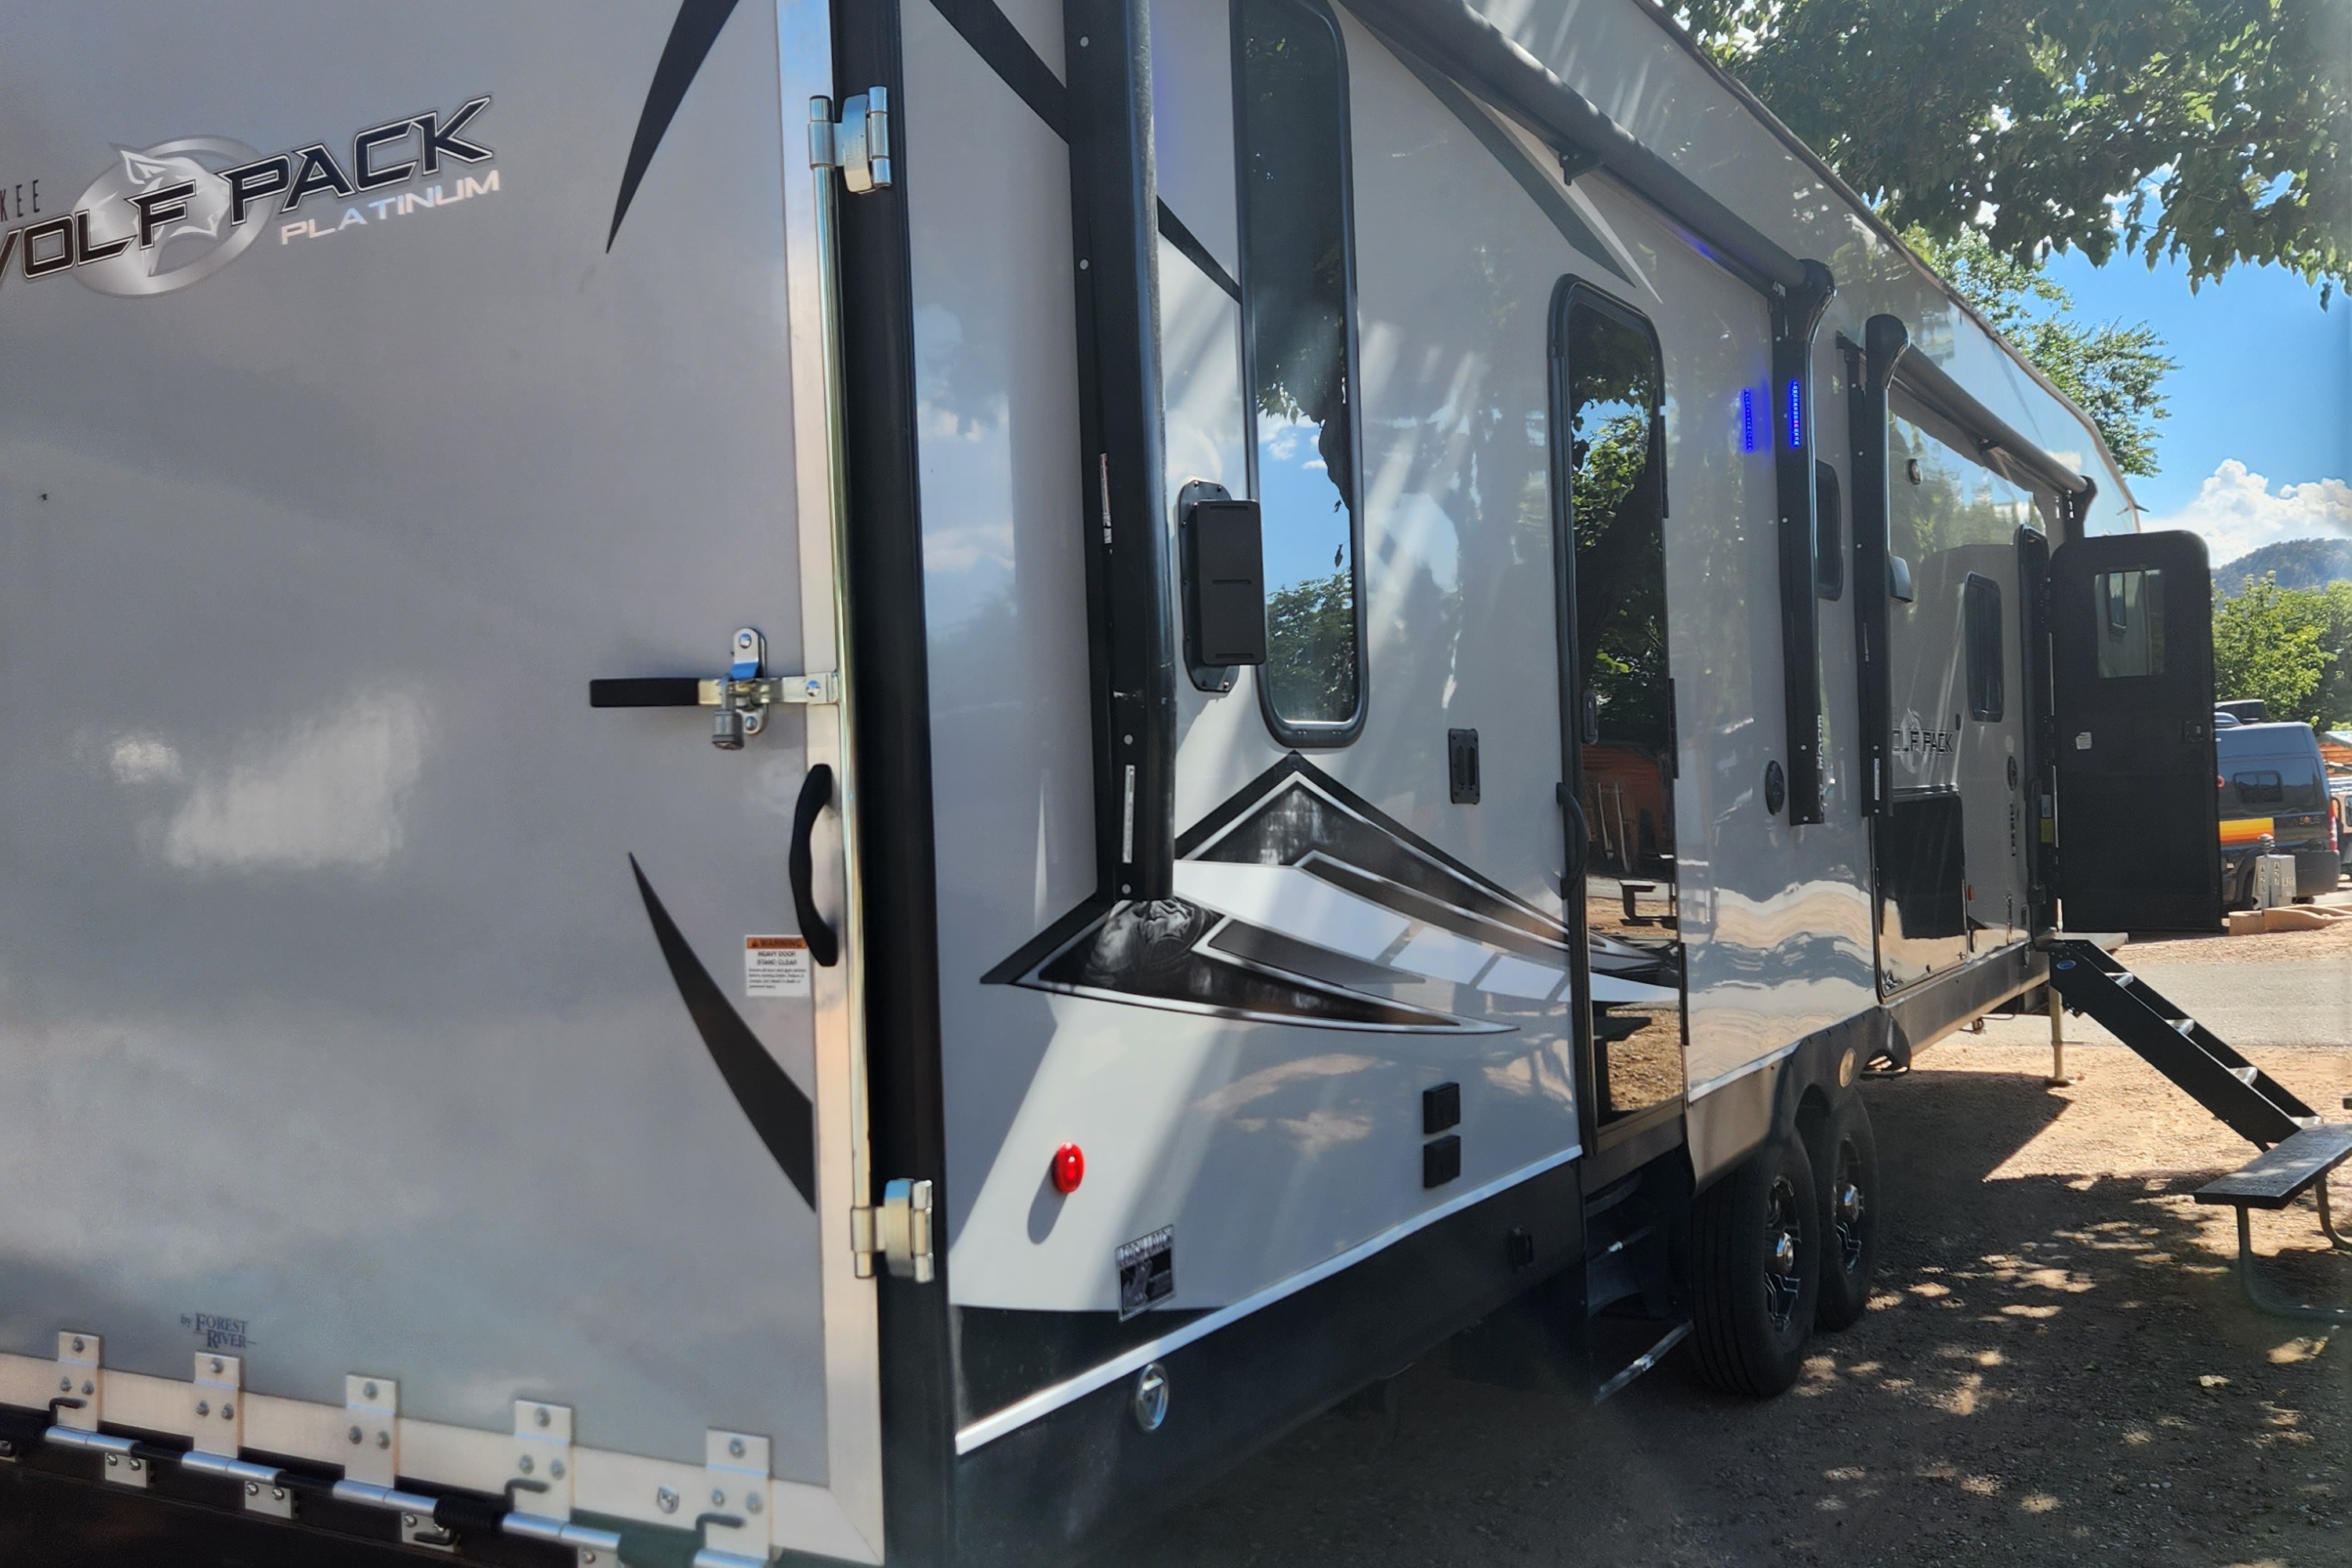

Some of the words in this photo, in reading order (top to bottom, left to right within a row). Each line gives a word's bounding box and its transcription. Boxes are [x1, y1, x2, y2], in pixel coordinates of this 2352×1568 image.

[0, 179, 196, 282] OLF
[219, 94, 494, 227] PACK
[280, 169, 500, 245] PLATINUM
[1922, 730, 1954, 755] PACK
[761, 938, 802, 948] WARNING
[180, 1313, 191, 1328] by
[195, 1312, 249, 1334] FOREST
[206, 1329, 247, 1349] RIVER
